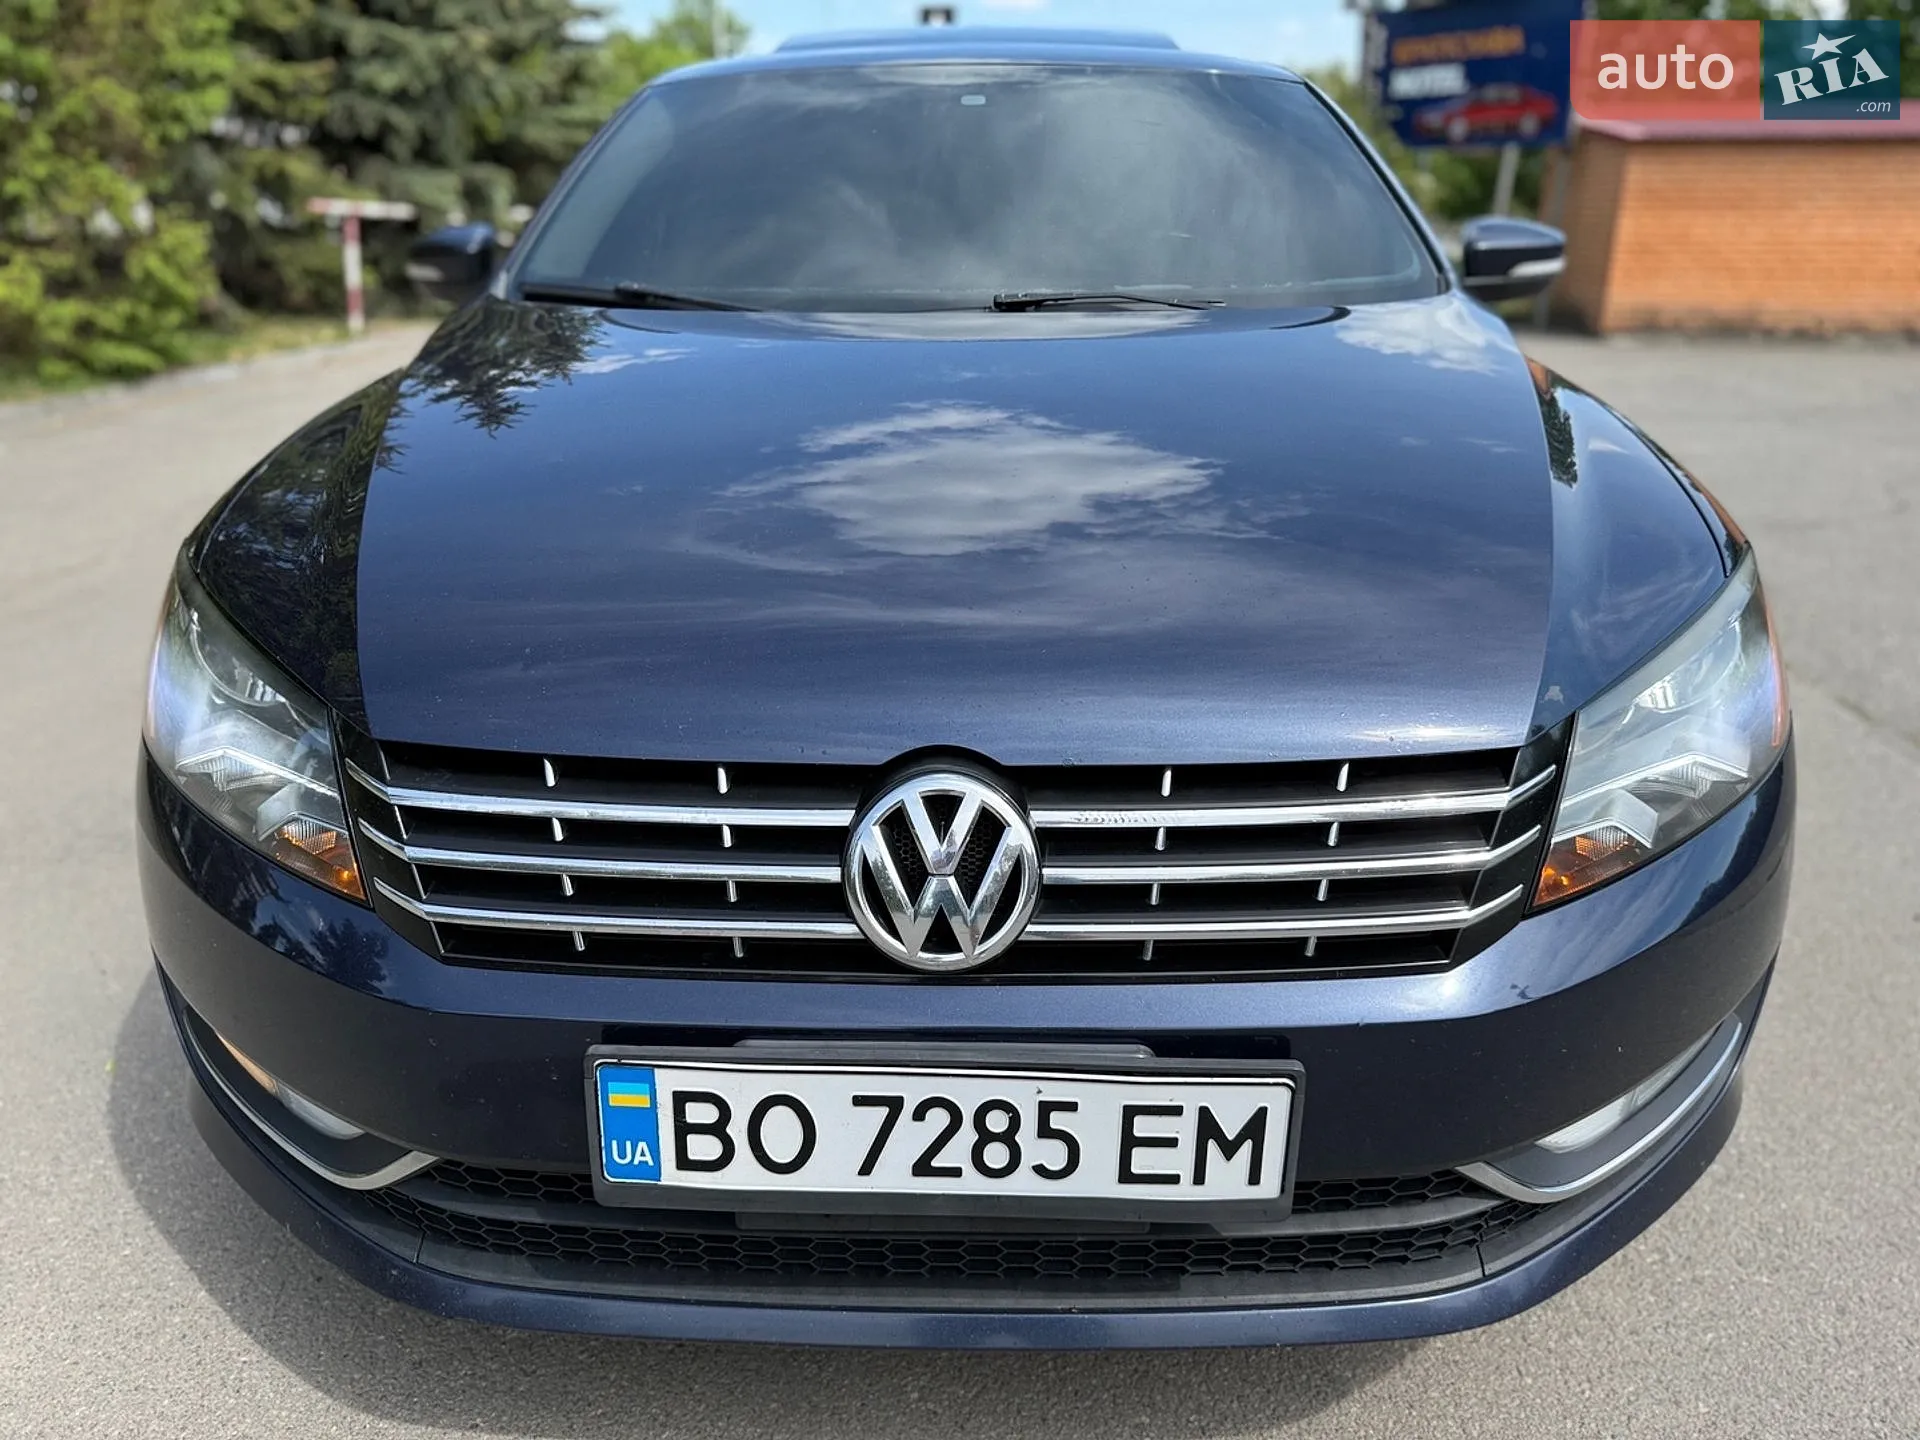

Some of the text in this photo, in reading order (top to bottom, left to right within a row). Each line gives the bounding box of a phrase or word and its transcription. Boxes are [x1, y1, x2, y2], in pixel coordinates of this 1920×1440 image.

[611, 1139, 655, 1167] UA
[671, 1090, 1269, 1187] BO 7285 EM
